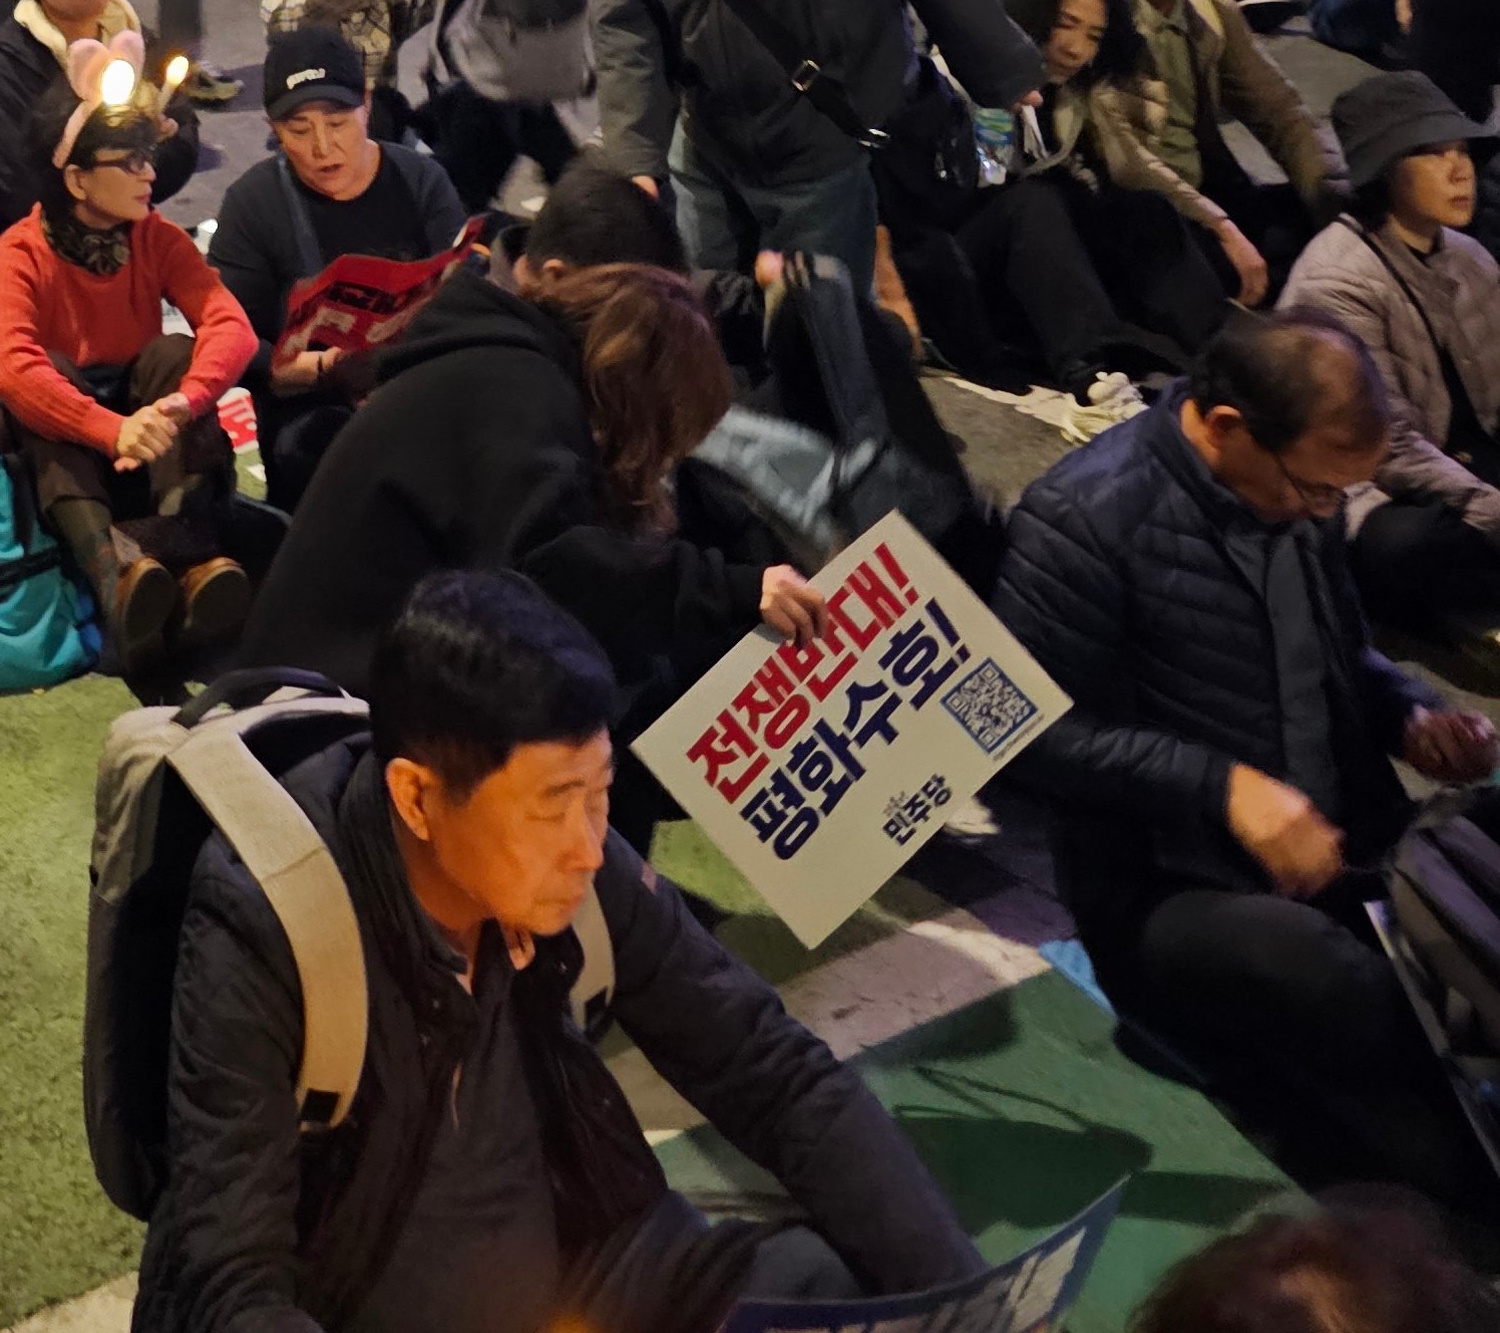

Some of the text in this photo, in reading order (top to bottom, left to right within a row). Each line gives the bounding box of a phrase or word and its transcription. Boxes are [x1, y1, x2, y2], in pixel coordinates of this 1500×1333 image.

[685, 541, 920, 806] 전쟁반대!
[739, 597, 972, 861] 평화수호!
[882, 773, 952, 846] 민주당
